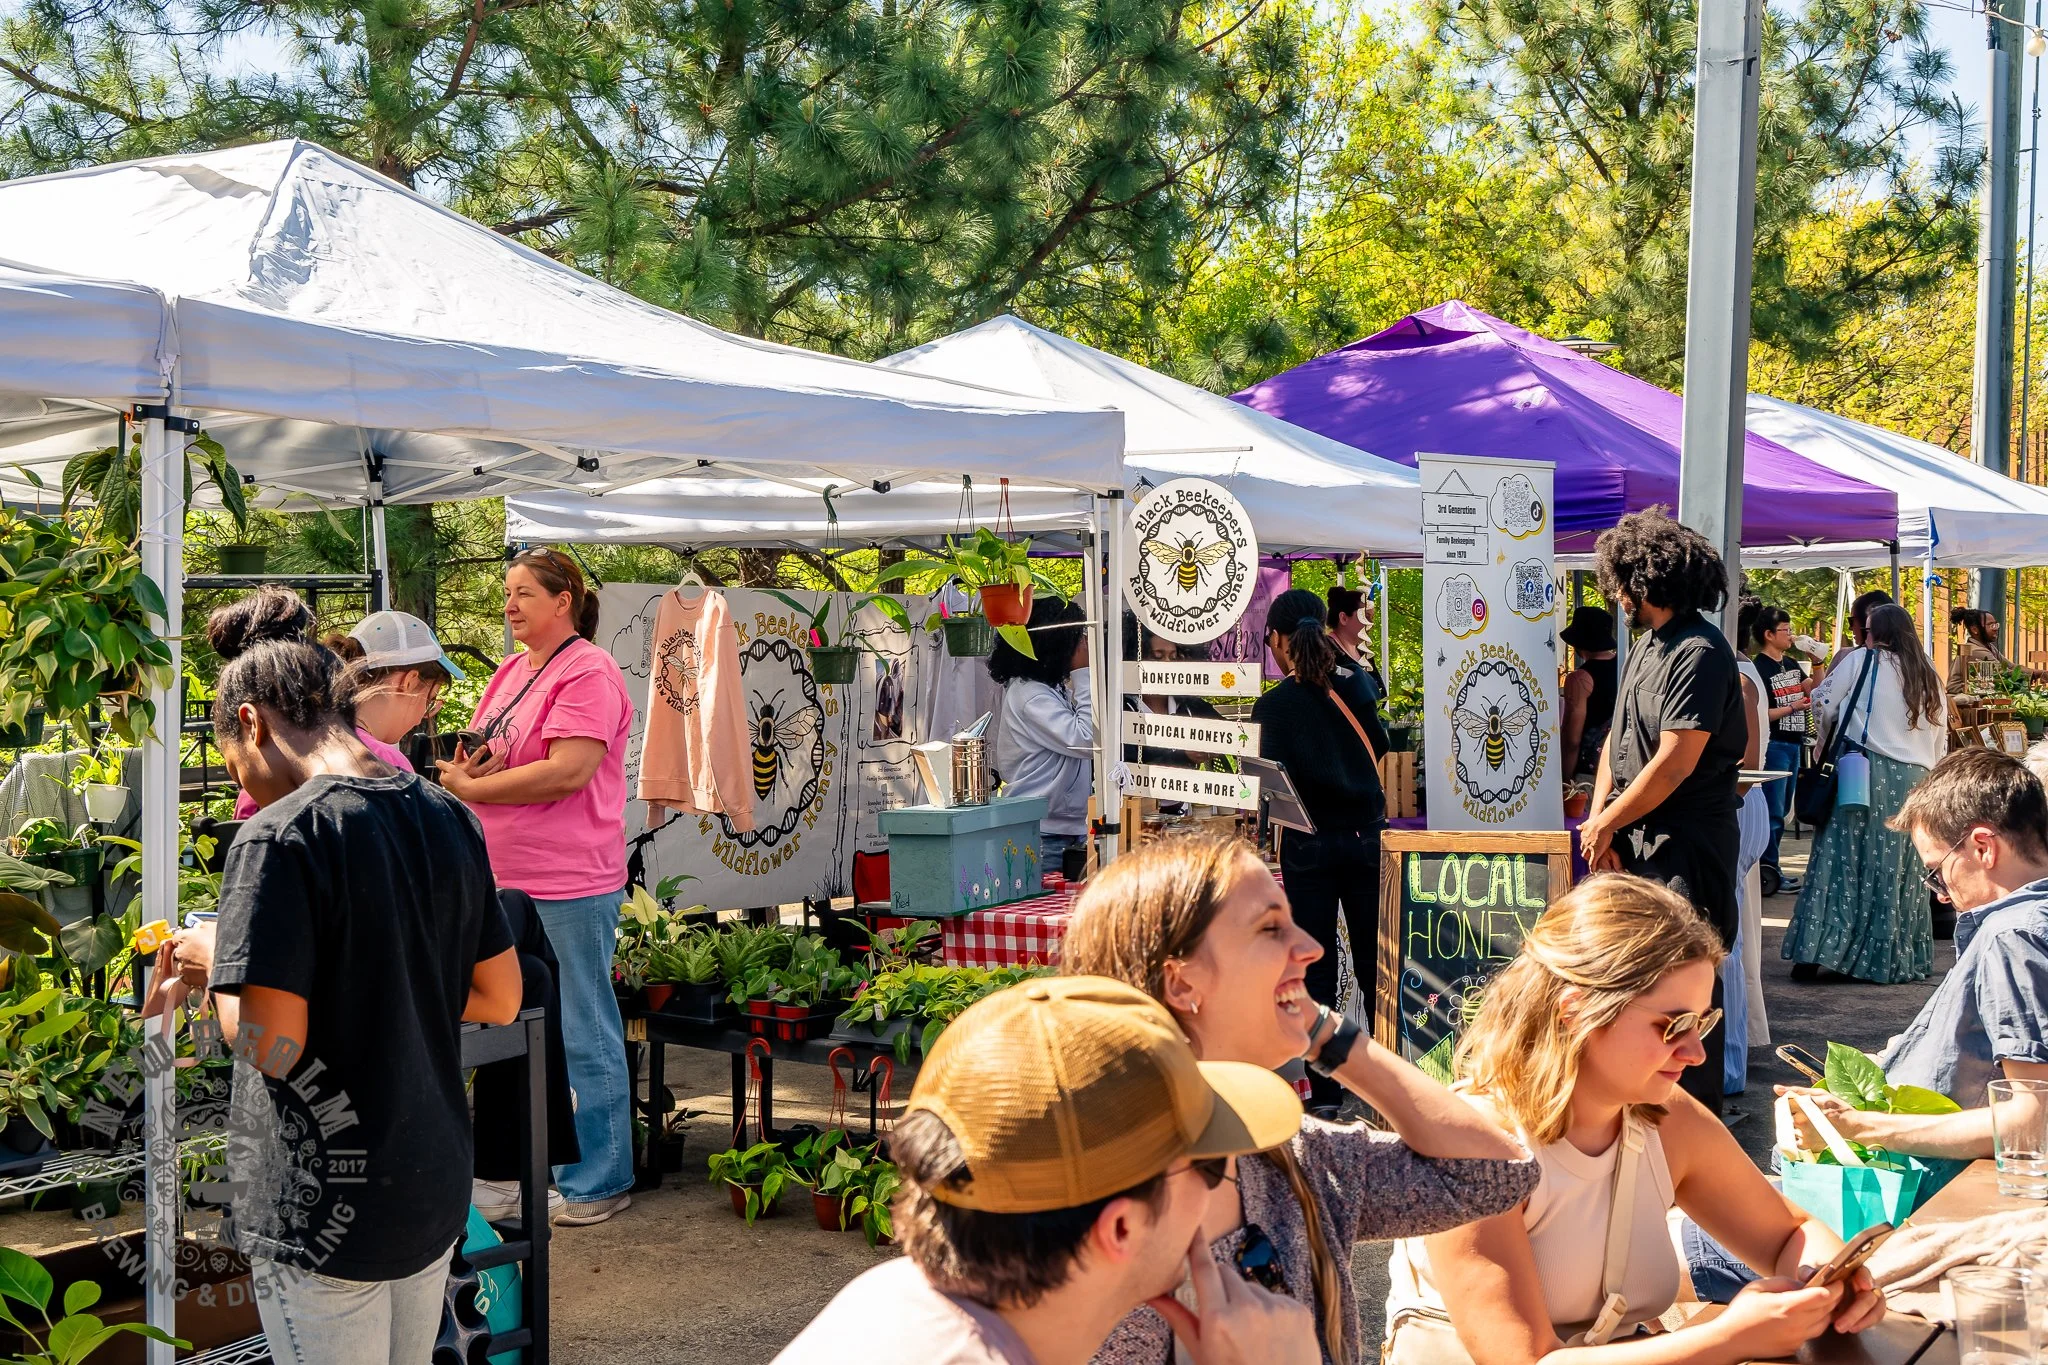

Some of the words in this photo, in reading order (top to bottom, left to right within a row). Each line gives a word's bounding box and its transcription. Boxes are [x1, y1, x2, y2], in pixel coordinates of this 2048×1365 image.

[1135, 494, 1173, 533] Black
[1176, 489, 1247, 549] Beekeepers
[1448, 504, 1476, 515] Generation
[1436, 535, 1450, 546] Family
[1451, 536, 1476, 547] Beekeeping
[1130, 574, 1150, 608] Raw
[1221, 561, 1248, 612] Honey
[1141, 671, 1210, 686] HONEYCOMB
[1447, 649, 1478, 700] Black
[1479, 642, 1549, 713] Beekeepers
[1132, 722, 1186, 739] TROPICAL
[1189, 728, 1234, 744] HONEYS
[803, 740, 838, 830] Honey
[1528, 728, 1551, 792] Honey
[1161, 777, 1189, 793] CARE
[1192, 783, 1200, 794] &
[1204, 783, 1235, 798] MORE
[1408, 852, 1547, 908] LOCAL
